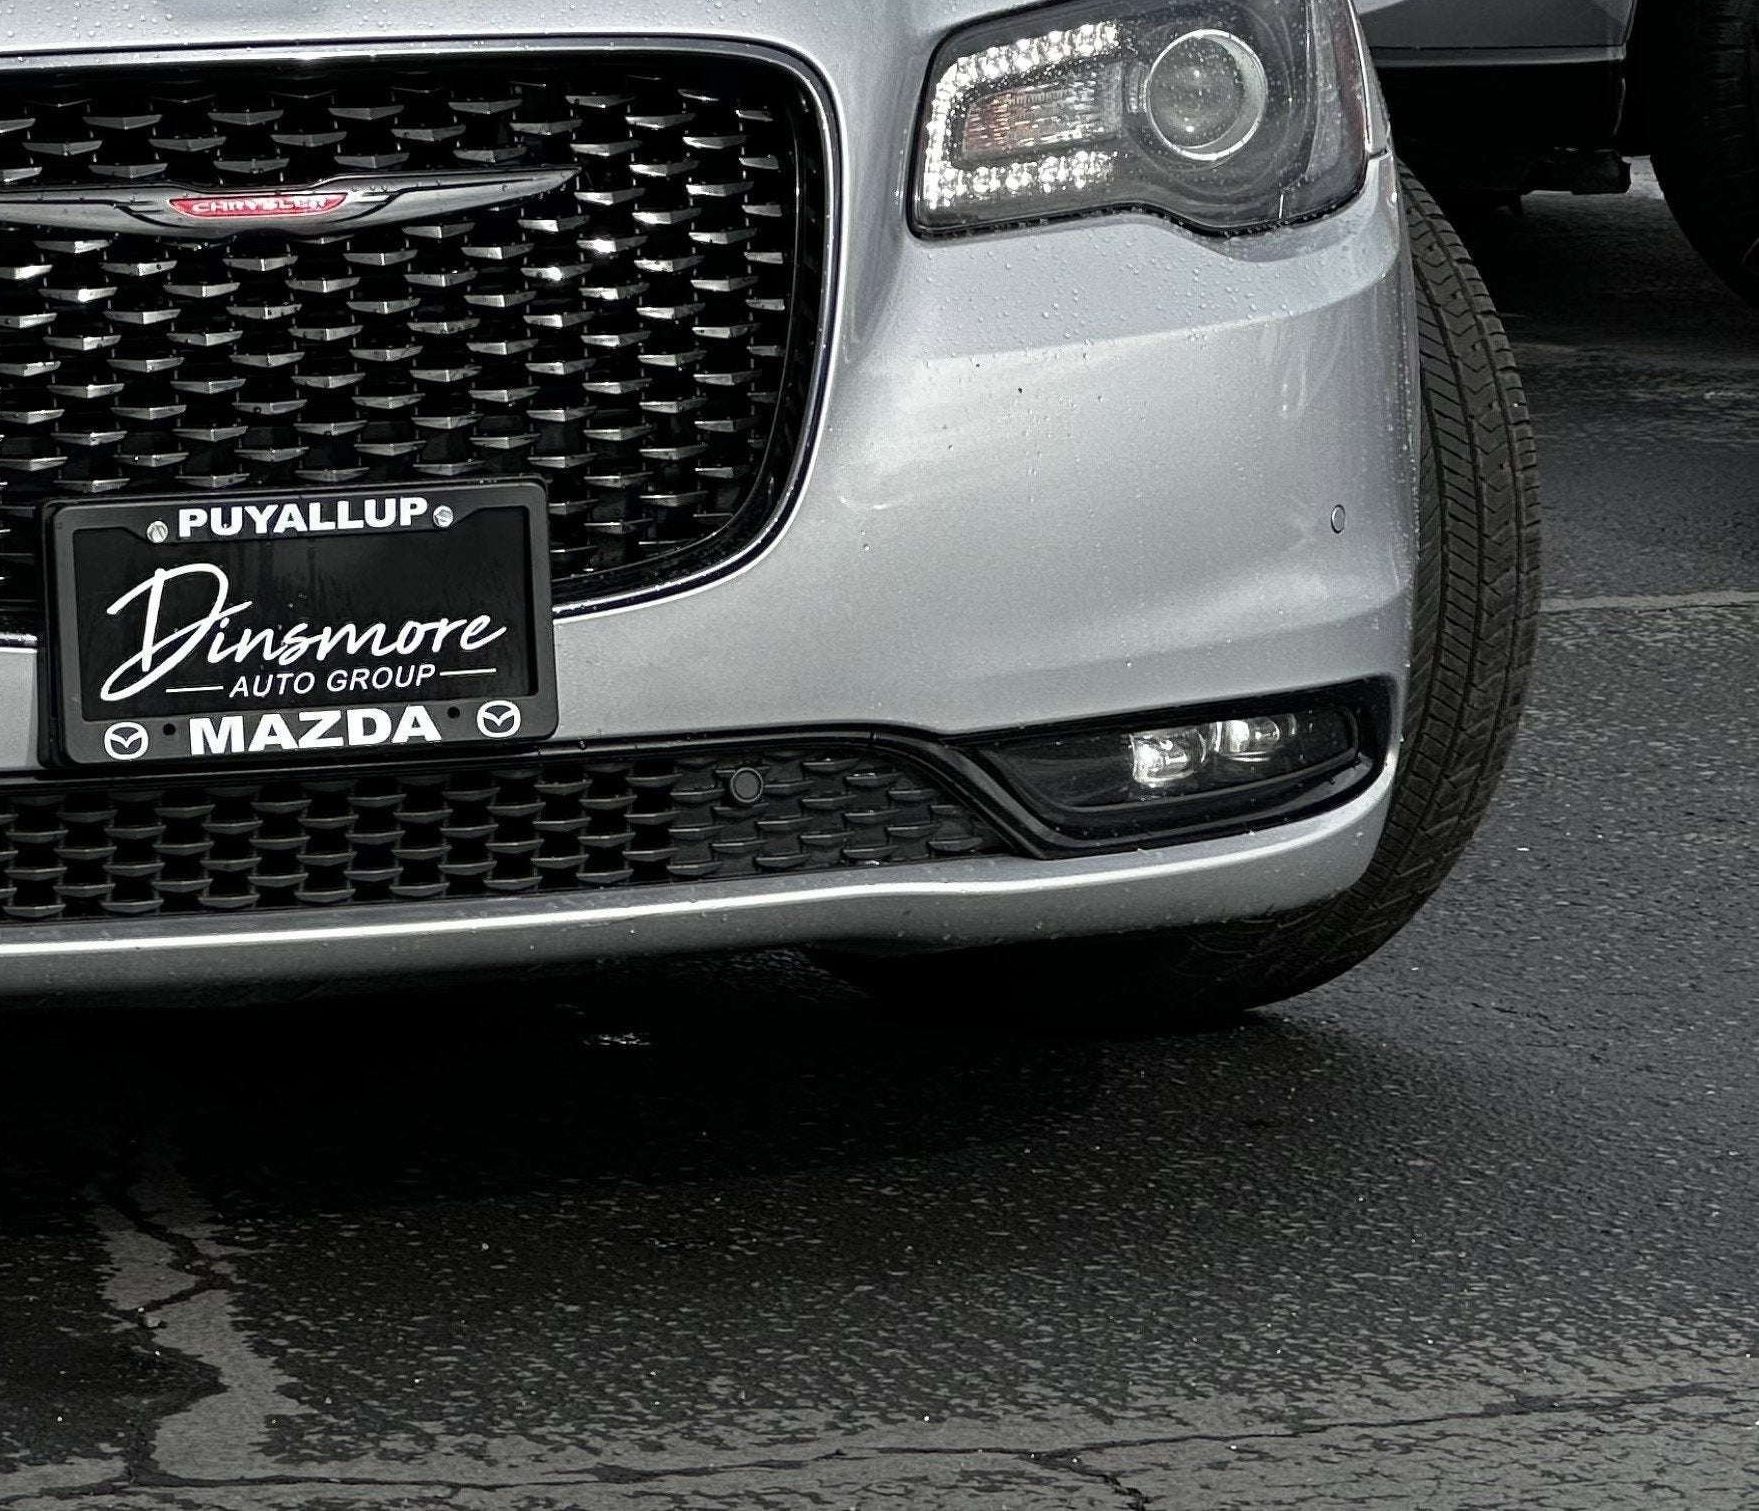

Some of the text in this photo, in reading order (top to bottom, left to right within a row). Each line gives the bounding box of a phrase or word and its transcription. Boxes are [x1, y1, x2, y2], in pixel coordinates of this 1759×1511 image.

[191, 195, 328, 214] CHRYSLER
[177, 496, 429, 538] PUYALLUP
[99, 562, 508, 703] Dinsmore
[228, 663, 437, 700] AUTO GROUP
[187, 704, 443, 757] MAZDA
